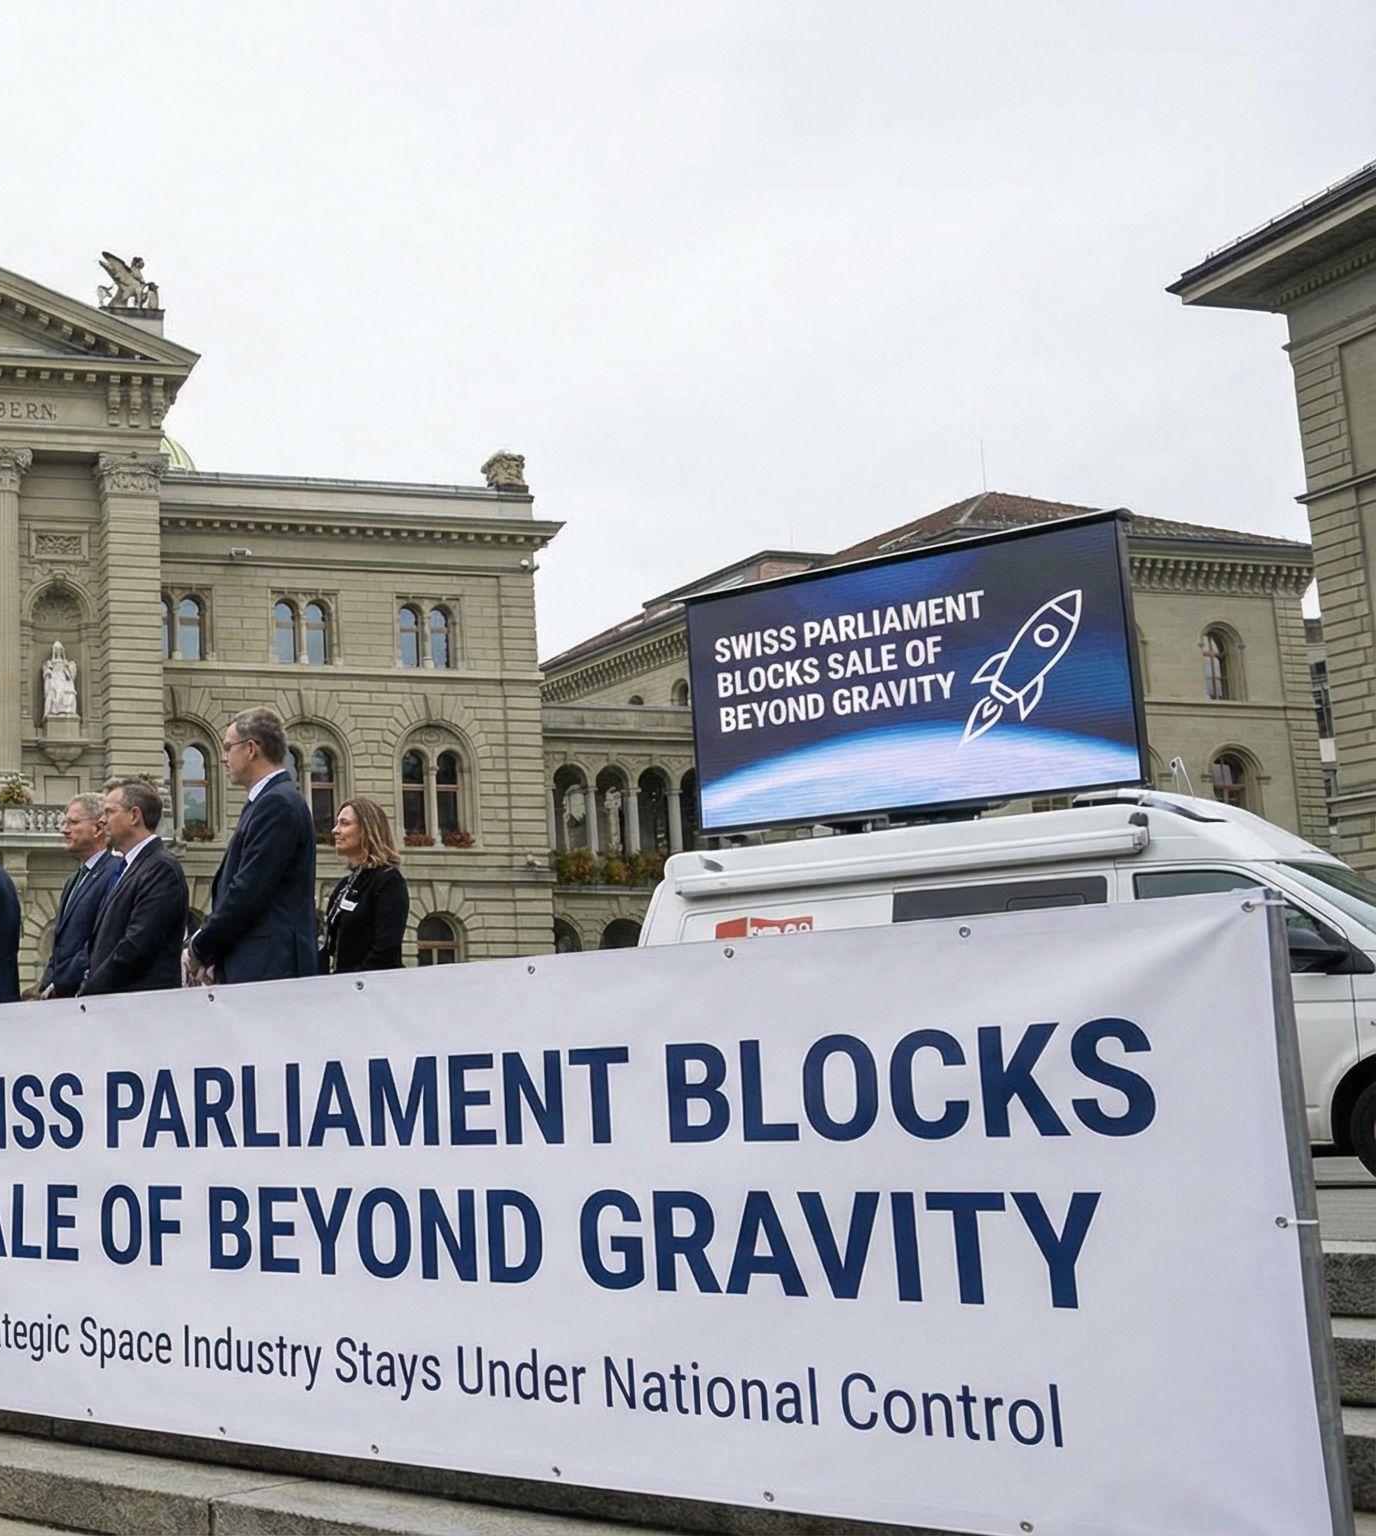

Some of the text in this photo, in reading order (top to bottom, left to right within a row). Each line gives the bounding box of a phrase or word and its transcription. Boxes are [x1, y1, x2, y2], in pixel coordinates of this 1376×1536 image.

[714, 589, 985, 663] SWISS PARLIAMENT
[717, 635, 943, 698] BLOCKS SALE OF
[719, 671, 956, 733] BEYOND GRAVITY
[106, 1045, 630, 1149] PARLIAMENT
[665, 1017, 1157, 1144] BLOCKS
[100, 1184, 182, 1267] OF
[208, 1186, 543, 1284] BEYOND
[579, 1189, 1102, 1310] GRAVITY
[79, 1316, 173, 1369] Space
[184, 1324, 323, 1392] Industry
[335, 1336, 442, 1402] Stays
[457, 1345, 587, 1406] Under
[603, 1355, 820, 1426] National
[841, 1372, 1064, 1448] Control
